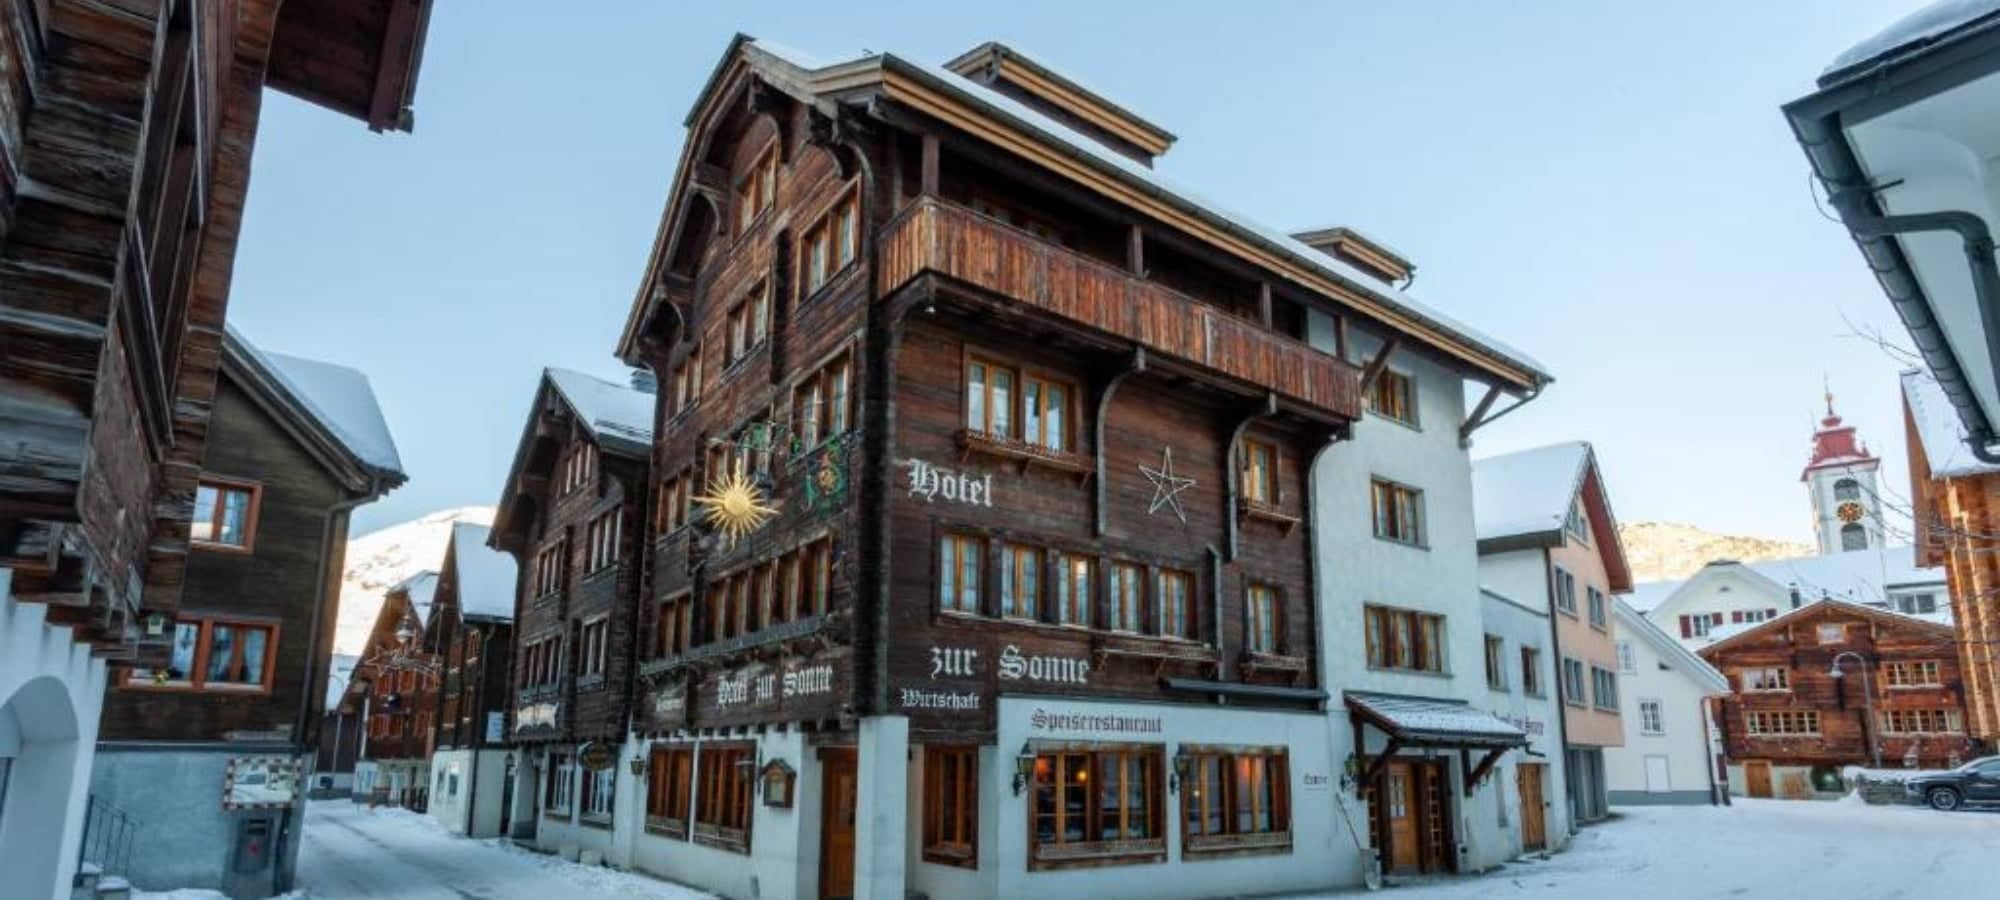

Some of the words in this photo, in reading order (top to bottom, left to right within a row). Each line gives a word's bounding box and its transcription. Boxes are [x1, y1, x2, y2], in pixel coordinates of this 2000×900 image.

[907, 457, 993, 508] Hotel
[930, 646, 977, 680] zur
[998, 644, 1090, 685] Sonne
[782, 665, 833, 697] Sonne
[901, 688, 980, 710] Wirtschaft
[1031, 707, 1162, 733] Speiserestaurant
